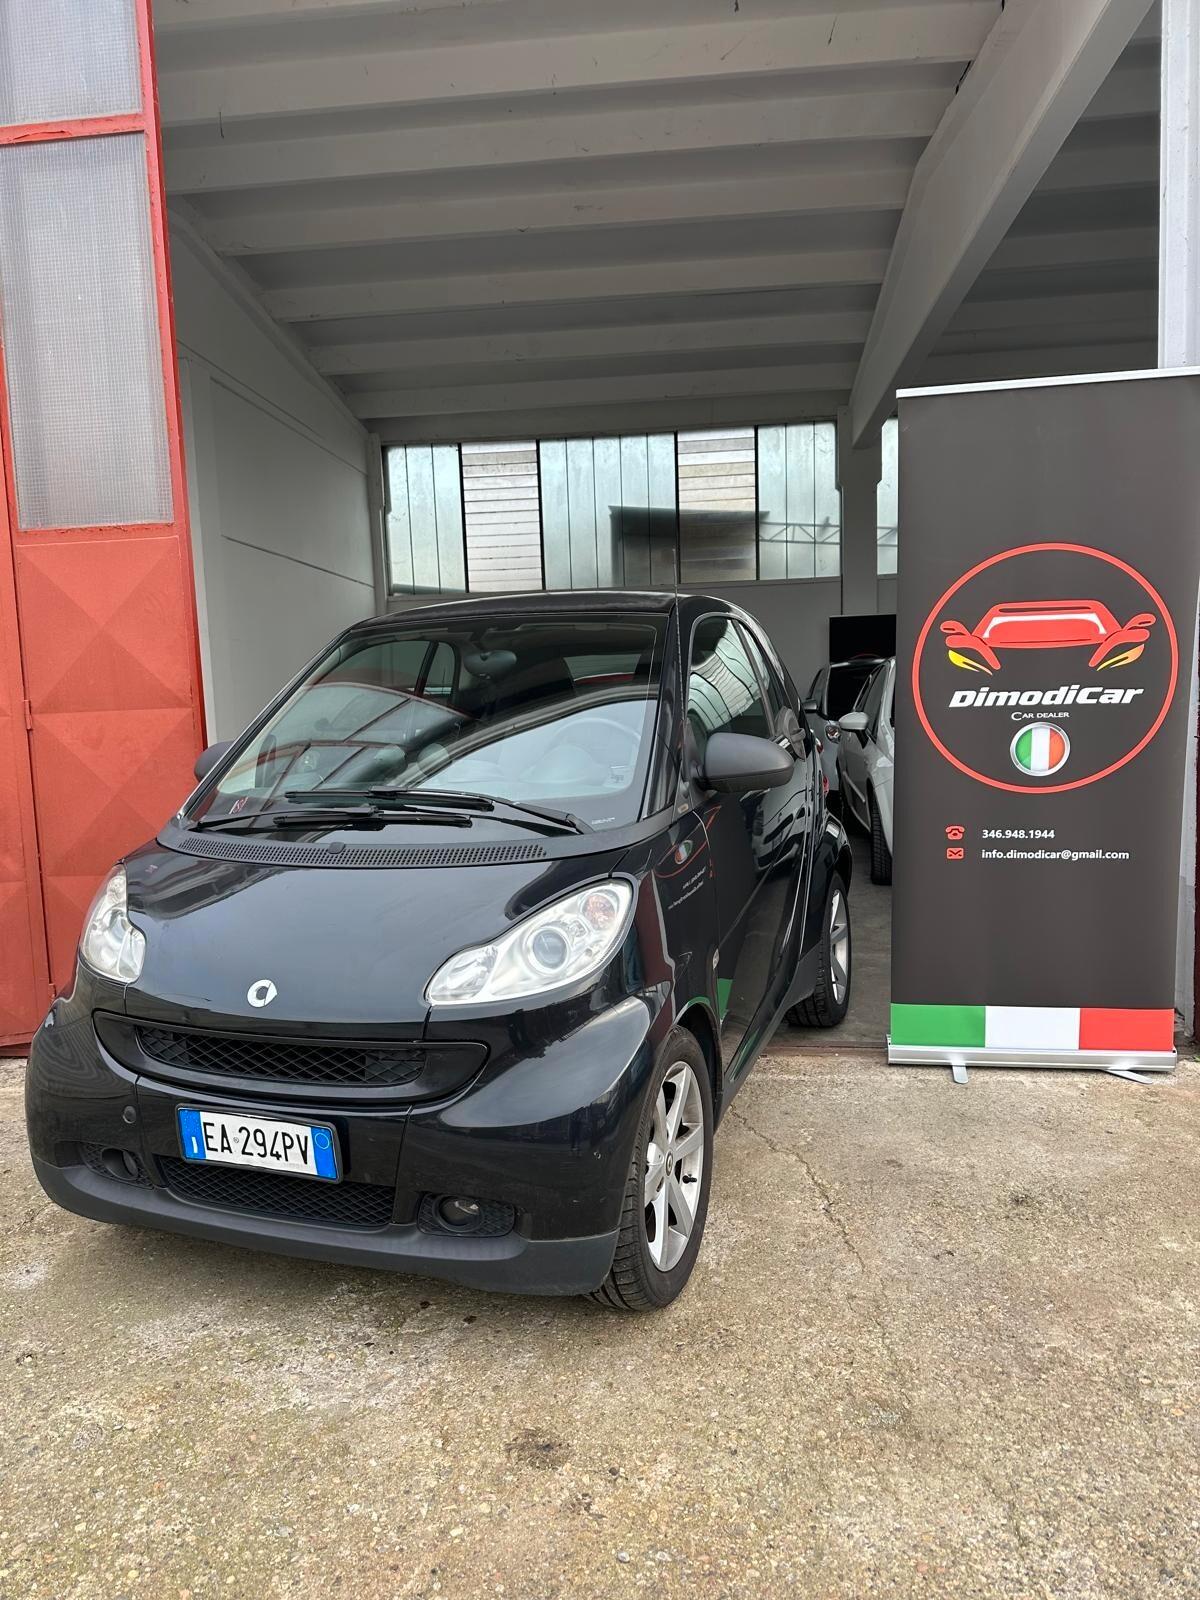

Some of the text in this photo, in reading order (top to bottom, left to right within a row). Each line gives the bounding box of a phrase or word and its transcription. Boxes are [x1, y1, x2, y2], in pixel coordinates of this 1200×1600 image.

[948, 684, 1145, 708] DimodiCar
[981, 829, 1056, 839] 346.948.1944
[981, 849, 1130, 862] info.dimodicar@gmail.com
